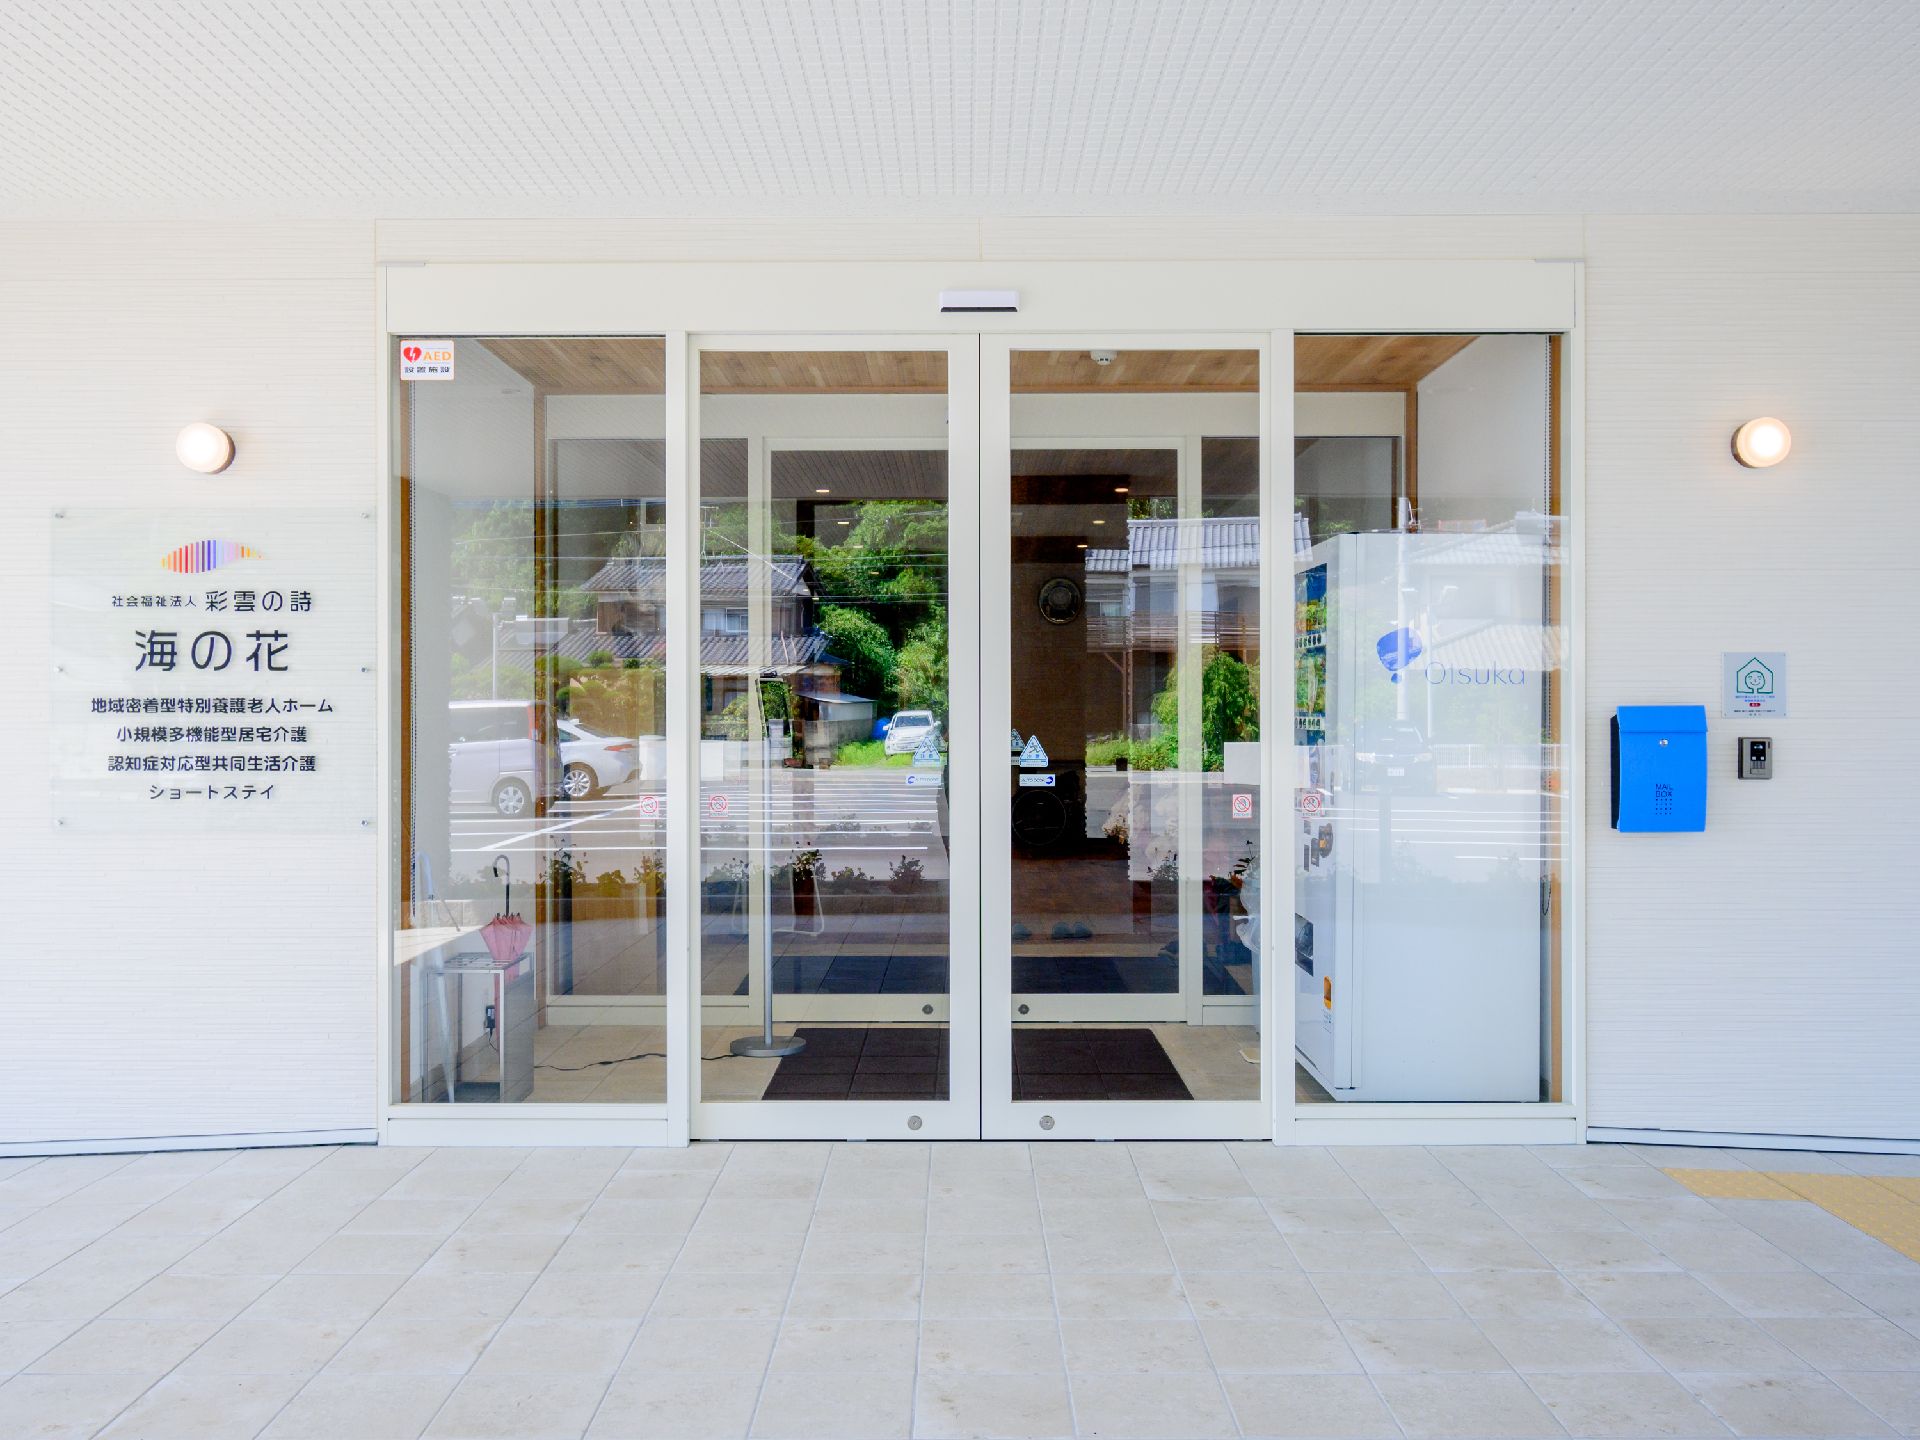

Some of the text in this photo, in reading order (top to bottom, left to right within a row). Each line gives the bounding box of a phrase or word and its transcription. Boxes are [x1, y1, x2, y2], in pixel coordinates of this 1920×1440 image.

[423, 351, 452, 361] AED
[111, 590, 312, 612] 社会福祉法人 彩雲の詩
[135, 629, 289, 672] 海の花
[91, 697, 334, 714] 地域密着型特別養護老人ホーム
[116, 725, 308, 743] 小規模多機能型居宅介護
[108, 755, 317, 772] 認知症対応型共同生活介護
[149, 784, 275, 800] ショートステイ
